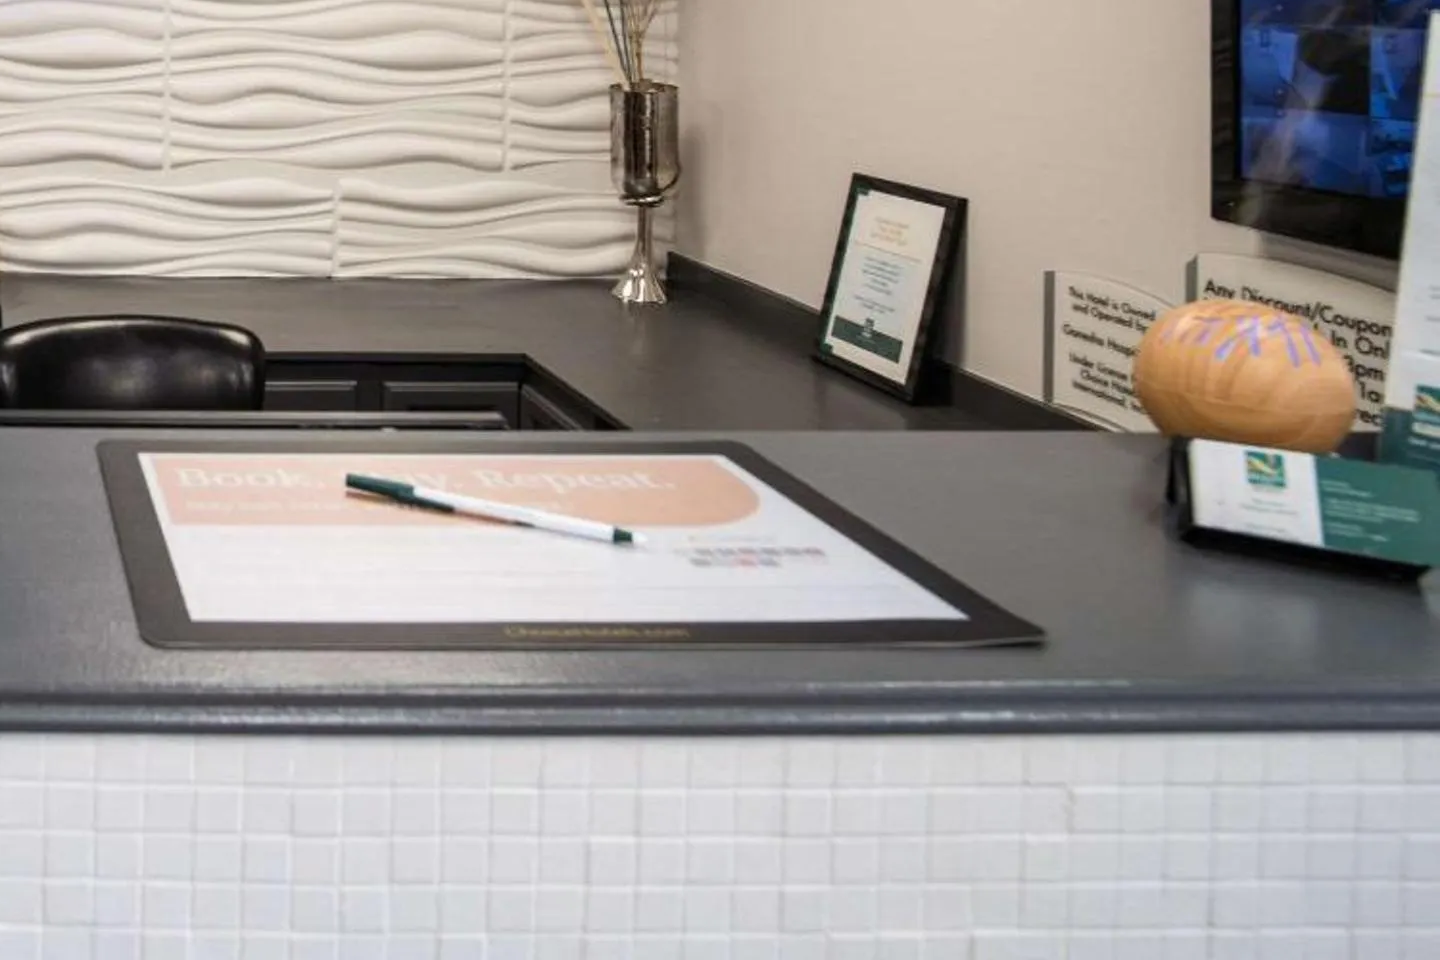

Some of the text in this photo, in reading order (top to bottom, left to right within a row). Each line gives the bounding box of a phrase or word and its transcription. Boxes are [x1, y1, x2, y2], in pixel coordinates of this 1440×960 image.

[1085, 293, 1110, 307] Hotel
[1120, 302, 1157, 321] Owned
[1090, 307, 1134, 329] Operated
[1354, 336, 1391, 360] Onl
